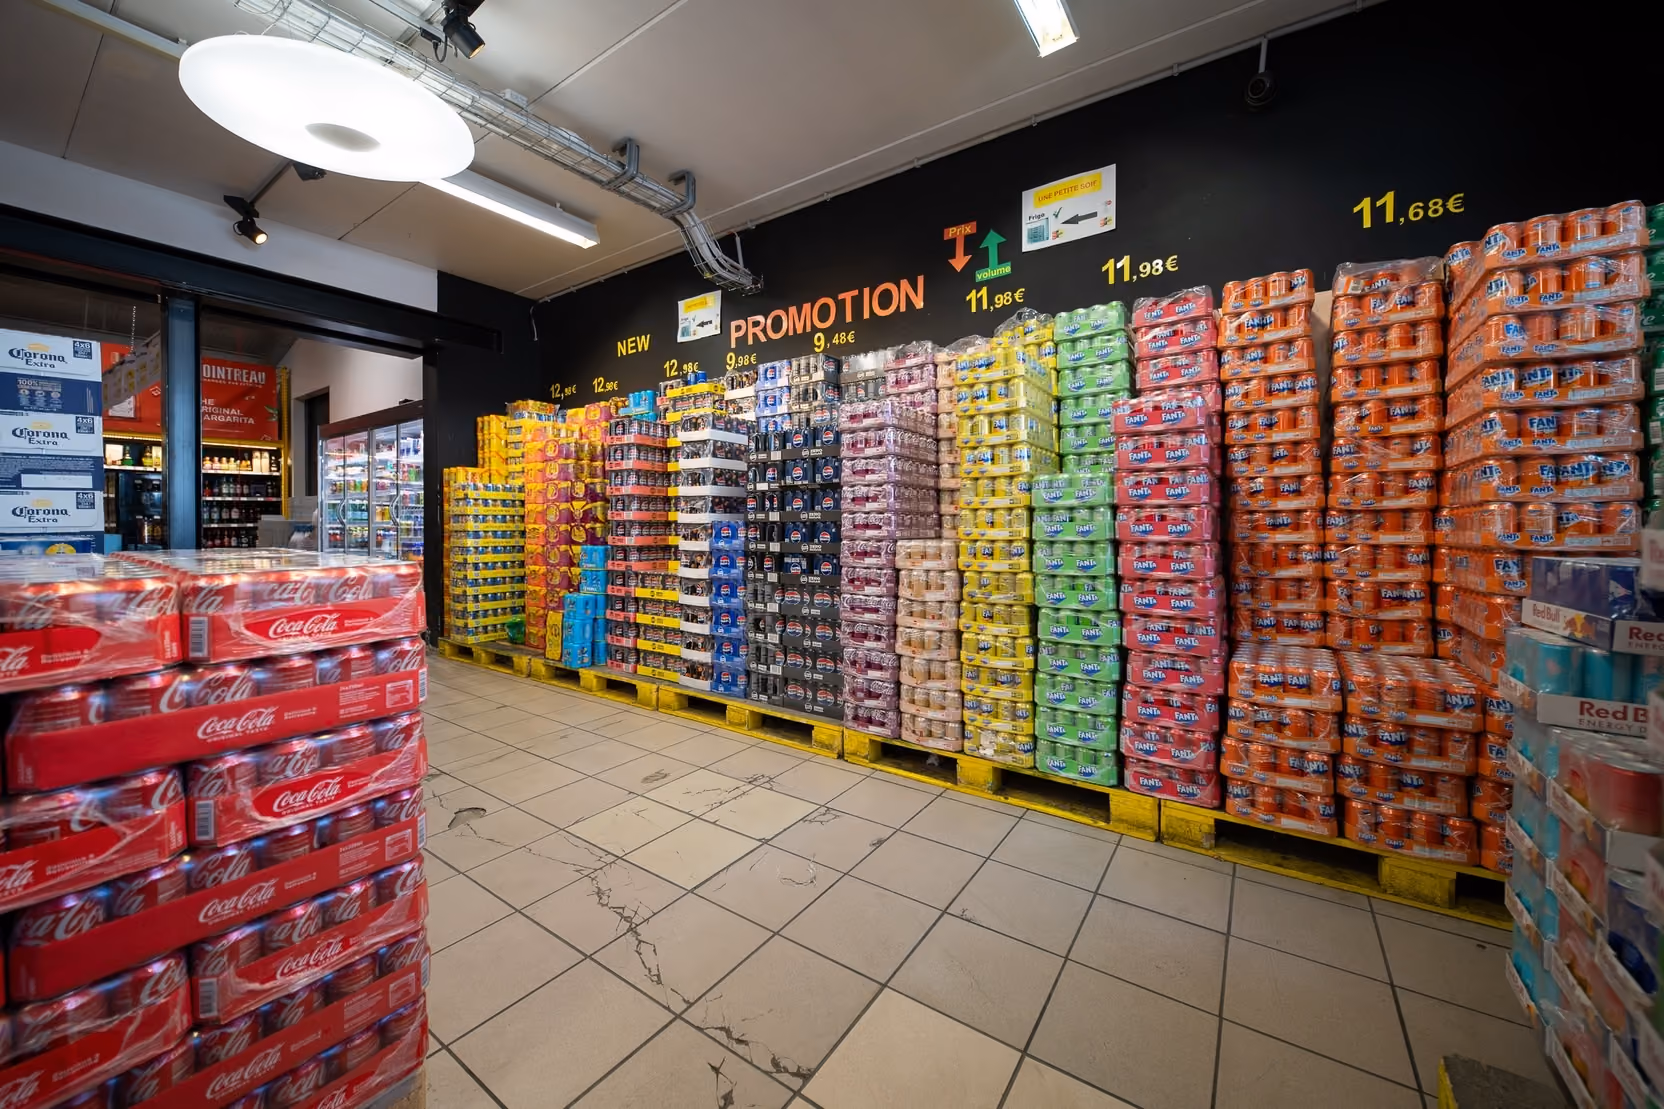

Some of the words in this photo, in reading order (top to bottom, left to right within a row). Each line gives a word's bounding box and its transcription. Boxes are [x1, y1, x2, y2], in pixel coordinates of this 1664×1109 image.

[1038, 191, 1053, 203] UNE
[1054, 184, 1079, 198] PETITE
[1352, 190, 1465, 228] 11,68€
[1028, 213, 1045, 222] Frigo
[948, 223, 972, 237] Prix
[1484, 232, 1507, 249] NTA
[1536, 244, 1560, 254] FANTA
[976, 265, 1011, 281] volume
[1101, 254, 1179, 285] 11,98€
[1487, 279, 1508, 294] NTA
[966, 286, 1025, 313] 11,98€
[1539, 292, 1564, 302] FANTA
[730, 274, 924, 349] PROMOTION
[1175, 302, 1196, 314] FANTA
[1148, 339, 1168, 349] FANTA
[1180, 334, 1201, 345] FANTA
[74, 341, 91, 349] 4x6
[617, 333, 650, 358] NEW
[8, 347, 66, 363] Corona
[25, 358, 56, 368] Extra
[726, 352, 757, 370] 9,98€
[663, 359, 699, 377] 12,98€
[1181, 366, 1201, 376] FANTA
[202, 364, 266, 384] OINTREAU
[593, 376, 619, 393] 12,98€
[1534, 391, 1558, 399] FANTA
[201, 398, 215, 406] HE
[201, 406, 244, 416] RIGINAL
[1162, 411, 1186, 421] FANTA
[203, 414, 255, 424] ARGARITA
[1125, 414, 1149, 423] FANTA
[1529, 417, 1556, 428] FAN
[11, 427, 69, 440] Corona
[28, 437, 58, 446] Extra
[1532, 438, 1556, 446] FANTA
[1165, 448, 1190, 459] FANTA
[1333, 444, 1354, 455] FANT
[1129, 451, 1152, 460] FANTA
[1280, 483, 1301, 492] FANT
[1408, 478, 1433, 488] FANT
[1129, 487, 1152, 496] FANTA
[1166, 487, 1190, 496] FANTA
[1530, 486, 1555, 494] FANTA
[11, 506, 69, 518] Corona
[1130, 524, 1154, 532] FANTA
[1167, 524, 1192, 533] FANTA
[1530, 534, 1555, 542] FANTA
[1133, 561, 1157, 569] FANTA
[1170, 562, 1195, 570] FANTA
[1504, 580, 1527, 588] FANTA
[1382, 589, 1401, 598] FAN
[1133, 597, 1157, 605] FANTA
[1171, 599, 1195, 608] FANTA
[1533, 604, 1546, 619] Red
[1546, 608, 1560, 622] Bull
[1256, 618, 1277, 626] FANT
[1283, 618, 1300, 627] FAN
[1300, 620, 1323, 629] FANT
[1137, 633, 1160, 641] FANTA
[1174, 637, 1200, 645] FANTA
[1628, 641, 1664, 651] ENERG
[1143, 670, 1166, 678] FANTA
[1180, 675, 1205, 683] FANTA
[1258, 673, 1284, 683] FANT
[1287, 674, 1310, 684] FAN
[1446, 695, 1476, 708] ANTA
[1137, 706, 1161, 715] FANTA
[1174, 711, 1199, 720] FANTA
[1579, 700, 1628, 721] Red
[1579, 717, 1632, 732] ENERGY
[1345, 725, 1369, 736] ANTA
[1378, 730, 1407, 742] FANT
[1134, 741, 1158, 750] FANTA
[1171, 748, 1196, 758] FANTA
[1140, 777, 1163, 786] FANTA
[1402, 774, 1425, 784] NTA
[1177, 785, 1201, 794] FANTA
